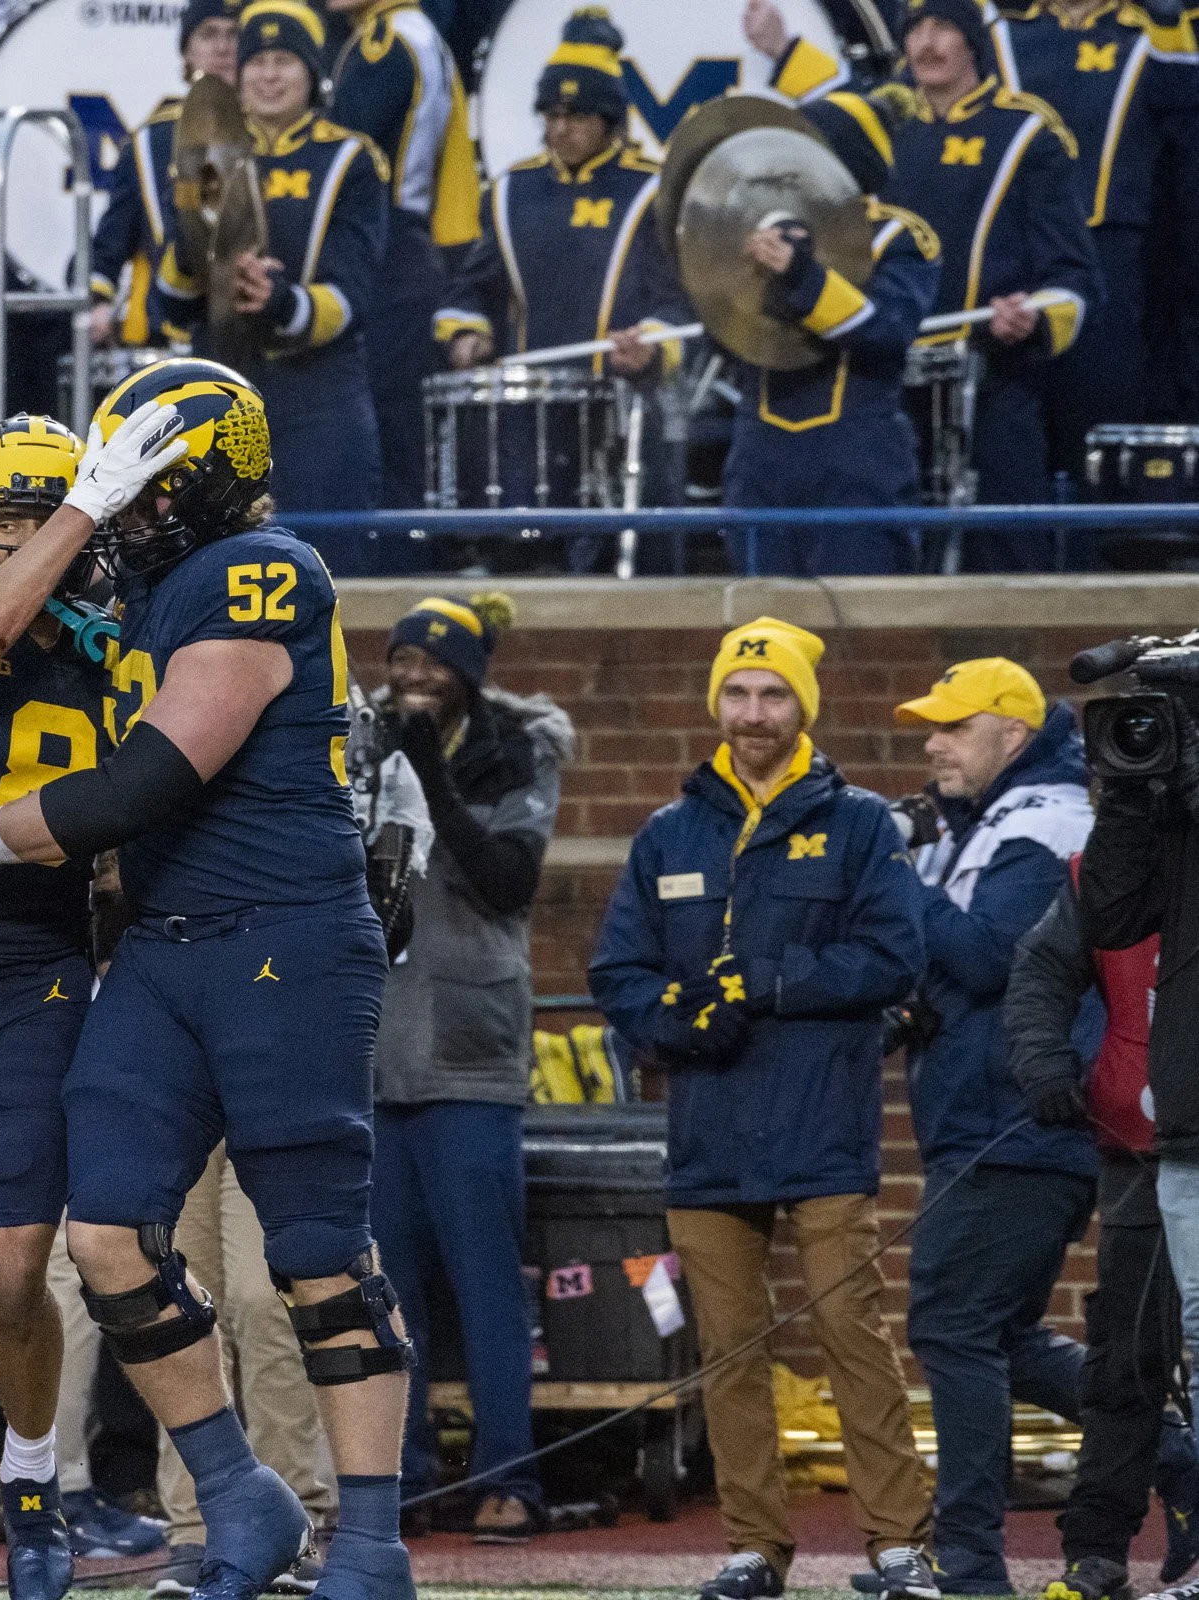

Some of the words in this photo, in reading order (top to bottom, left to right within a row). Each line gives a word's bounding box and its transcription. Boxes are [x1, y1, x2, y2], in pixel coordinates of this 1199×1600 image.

[1076, 41, 1118, 72] M
[941, 136, 985, 166] M
[264, 169, 311, 199] M
[570, 198, 613, 228] M
[30, 476, 46, 488] M
[227, 562, 297, 622] 52
[736, 639, 769, 657] M
[787, 833, 828, 860] M
[20, 1495, 42, 1511] M
